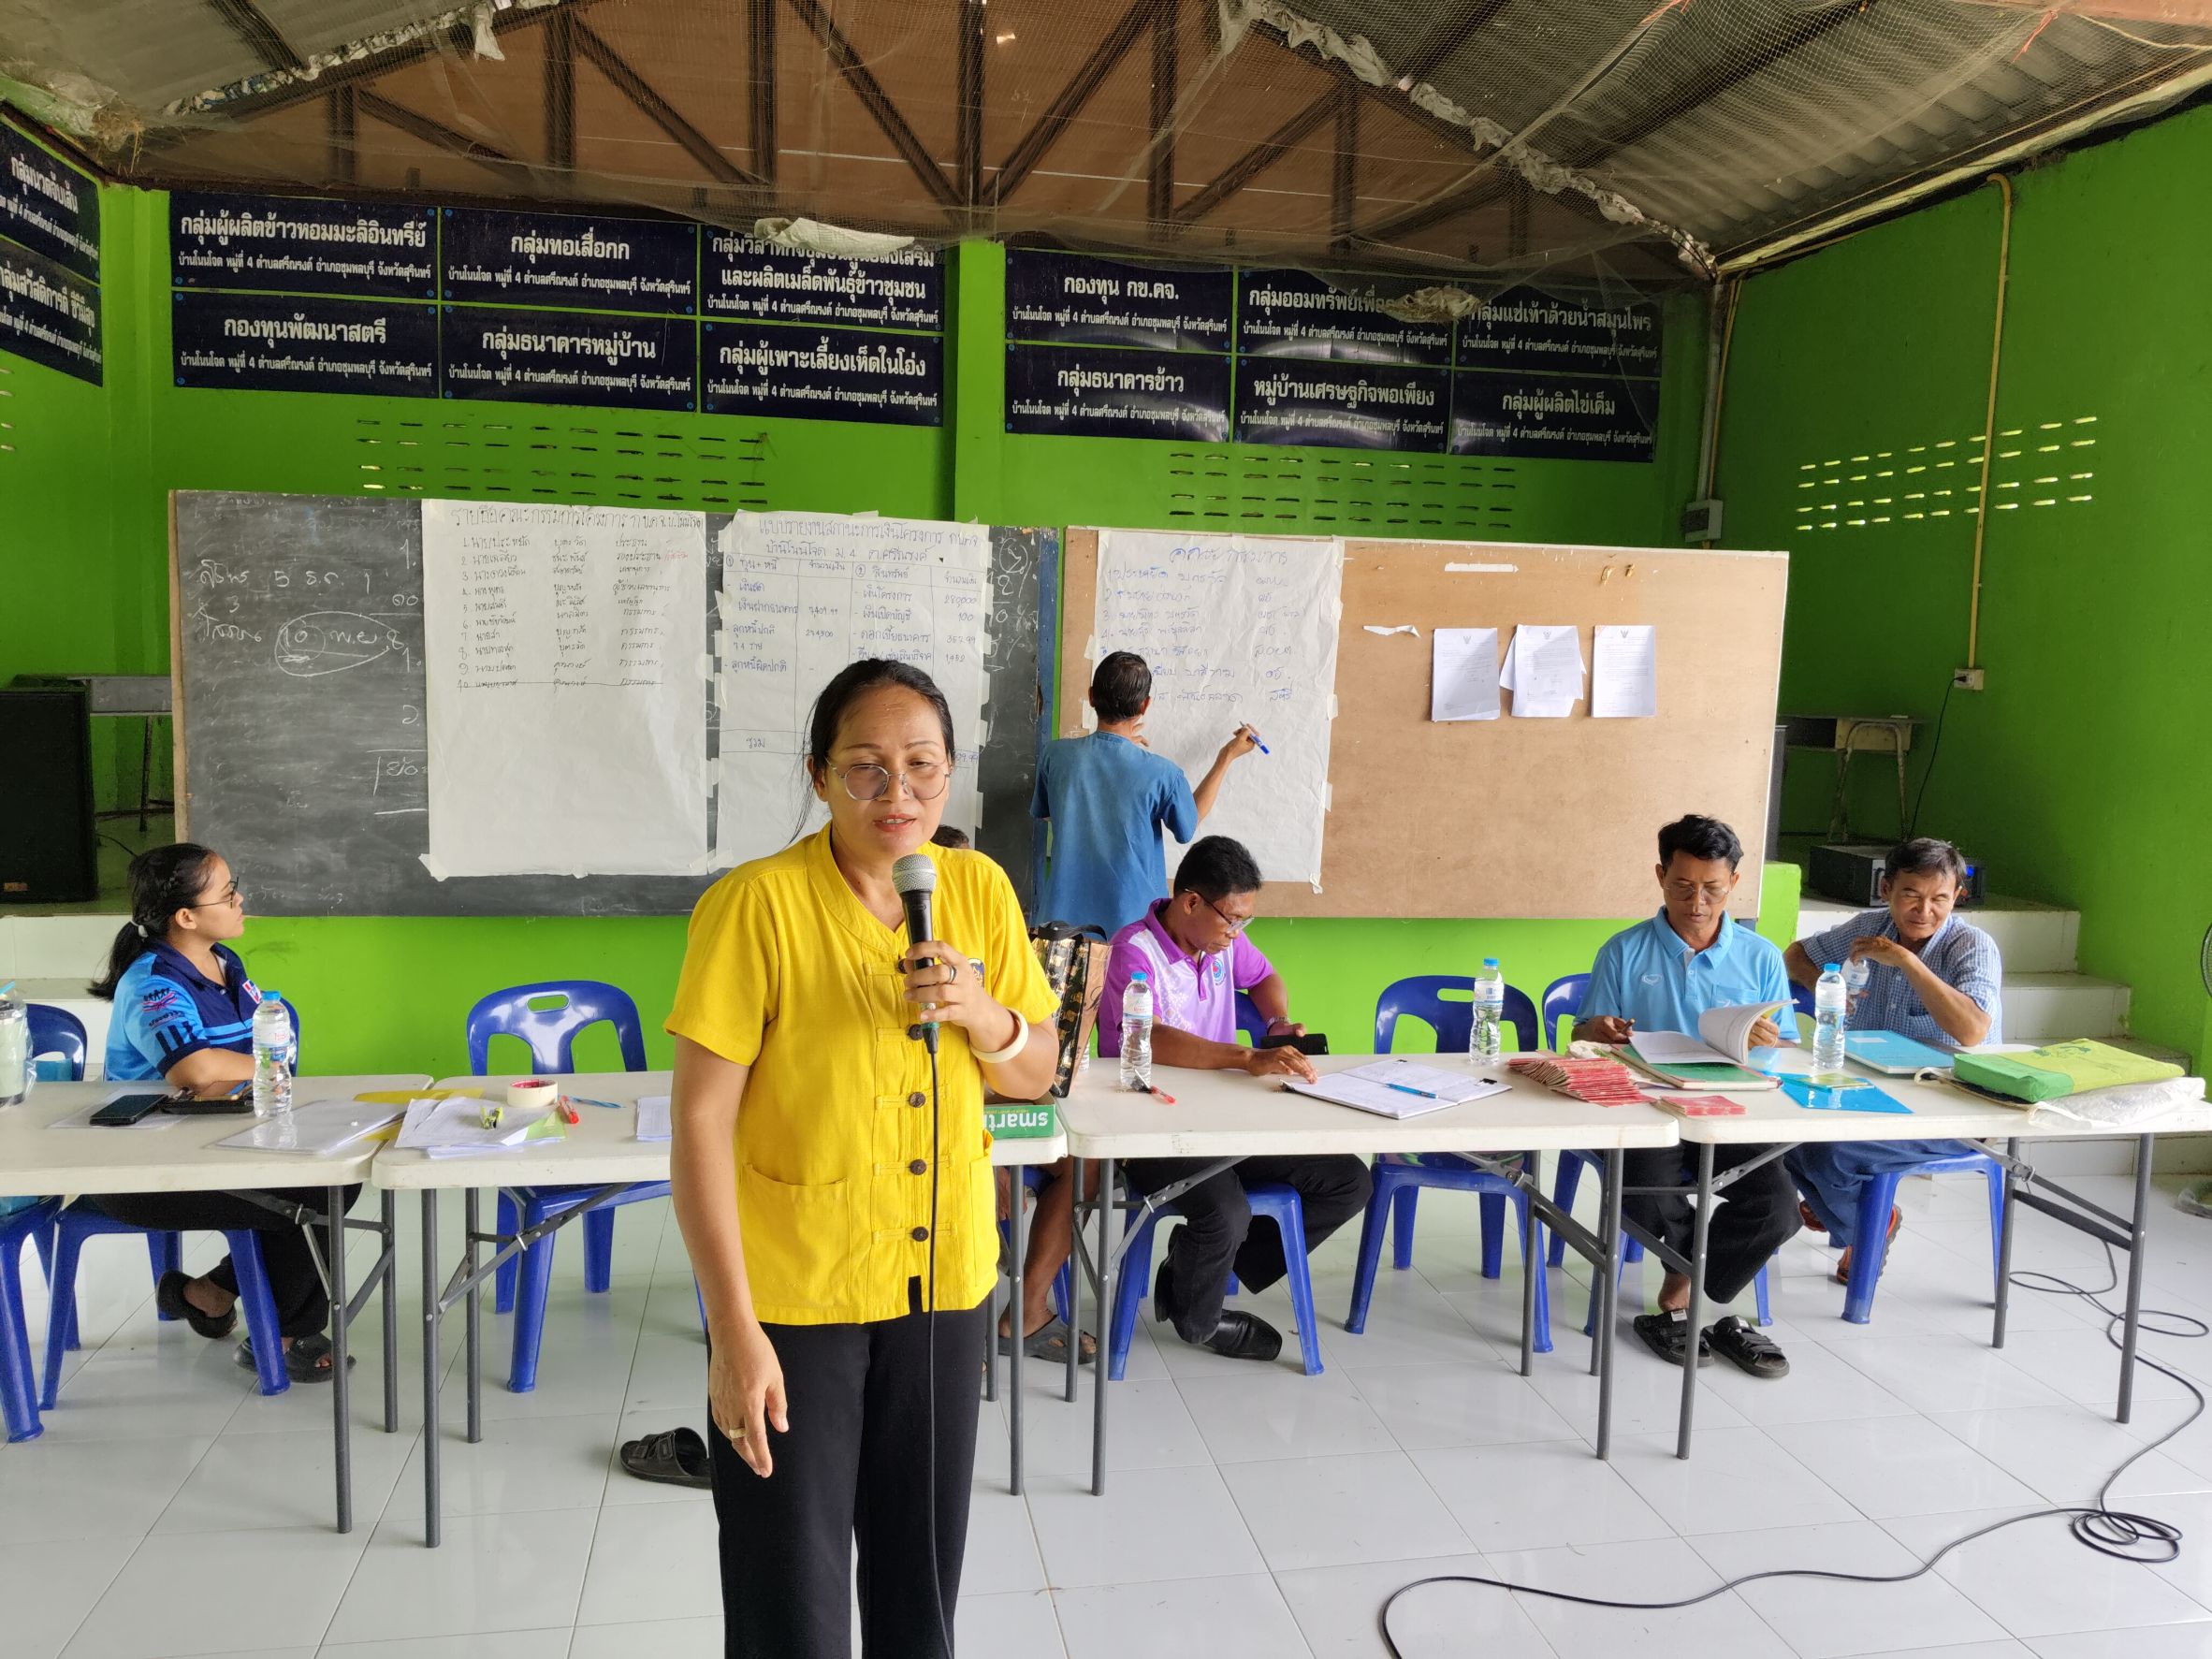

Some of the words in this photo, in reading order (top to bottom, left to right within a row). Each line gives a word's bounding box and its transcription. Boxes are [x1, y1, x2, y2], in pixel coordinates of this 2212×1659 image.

[181, 209, 427, 249] กลุ่มผู้ผลิตข้าวหอมมะลิอินทรีย์
[511, 227, 630, 264] กลุ่มทอเสื่อกก
[247, 256, 254, 268] 4
[515, 271, 521, 284] 4
[721, 265, 925, 306] และผลิตเมล็ดพันธุ์ข้าวชุมชน
[1064, 275, 1120, 305] กองทุน
[1128, 279, 1180, 300] กข.คจ.
[771, 301, 778, 313] 4
[1072, 313, 1078, 322] 4
[224, 313, 386, 348] กองทุนพัฒนาสตรี
[482, 326, 656, 366] กลุ่มธนาคารหมู่บ้าน
[249, 357, 255, 369] 4
[720, 336, 925, 378] กลุ่มผู้เพาะเลี้ยงเห็ดในโอ่ง
[515, 371, 521, 382] 4
[771, 386, 778, 397] 4
[1057, 364, 1184, 397] กลุ่มธนาคารข้าว
[1254, 373, 1435, 409] หมู่บ้านเศรษฐกิจพอเพียง
[1502, 387, 1615, 420] กลุ่มผู้ผลิตไข่เค็ม
[984, 1112, 1049, 1131] smart
